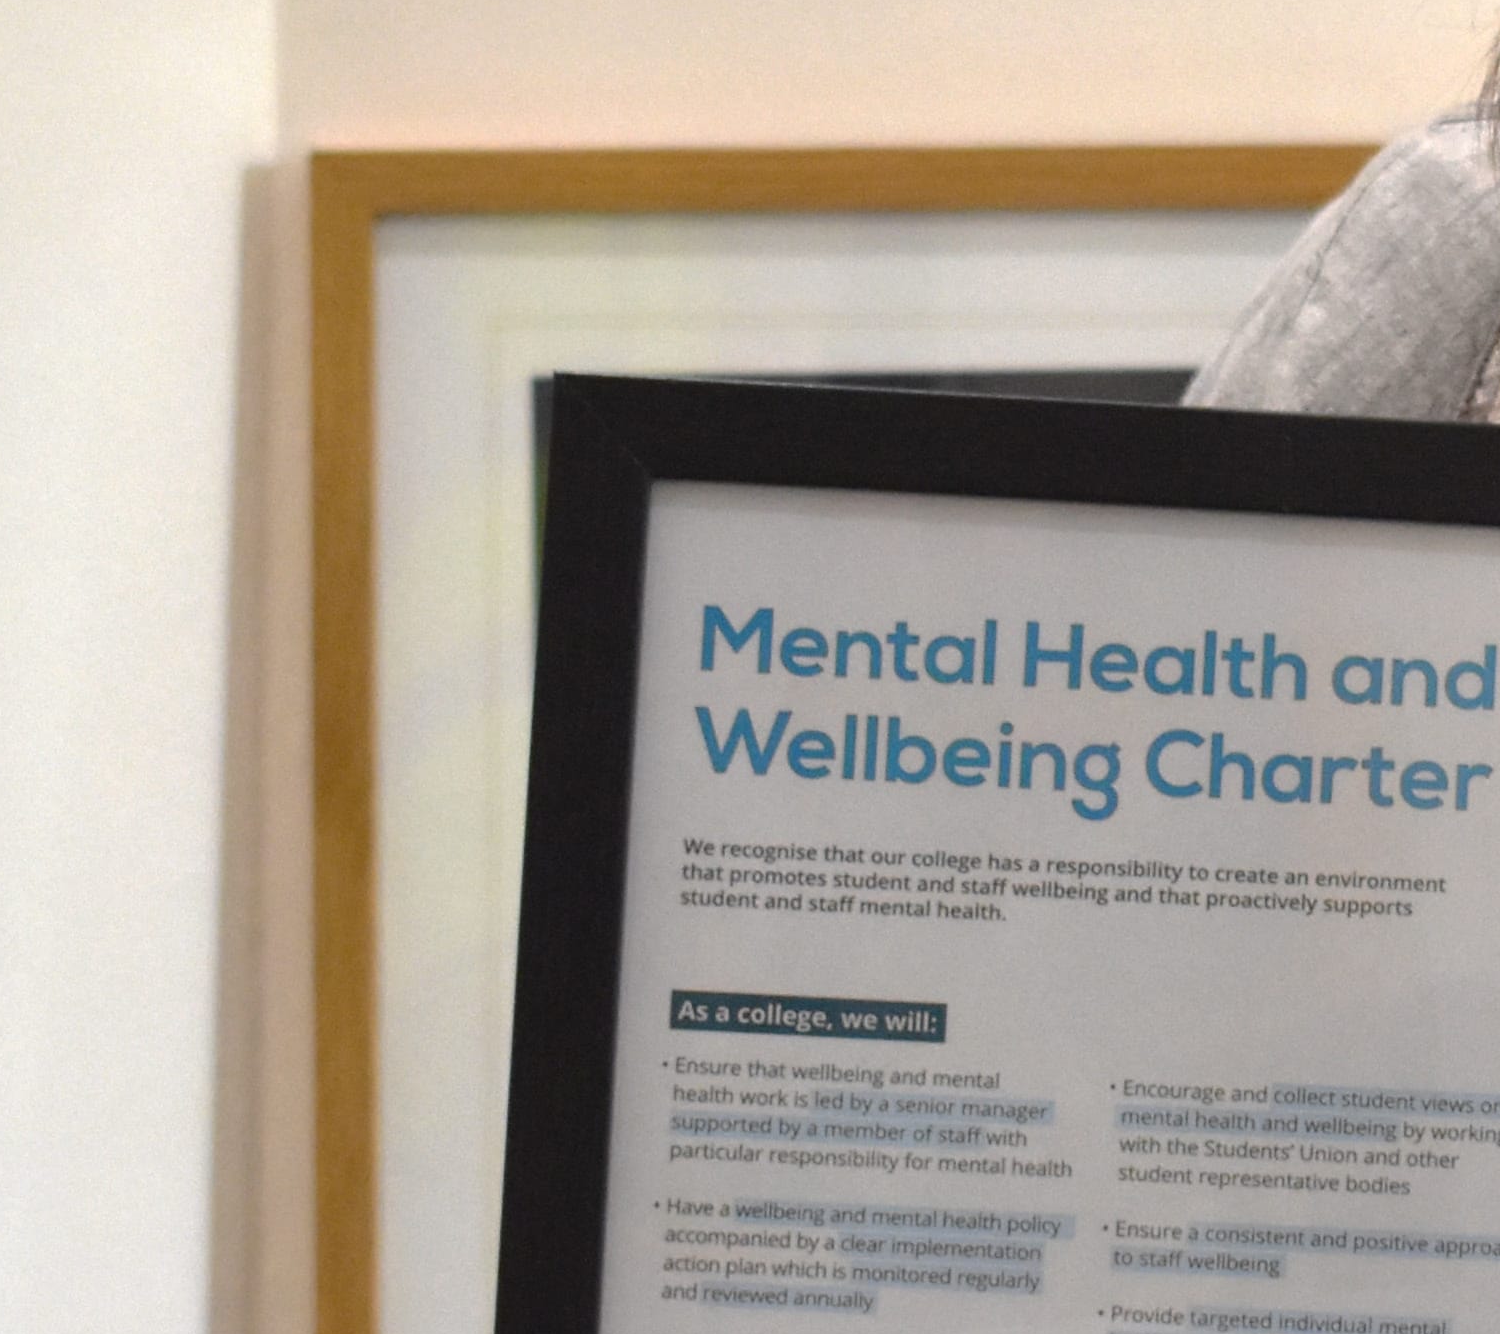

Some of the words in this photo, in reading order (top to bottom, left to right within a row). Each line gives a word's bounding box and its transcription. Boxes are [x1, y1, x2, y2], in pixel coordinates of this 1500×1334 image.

[700, 604, 998, 686] Mental
[1022, 620, 1308, 701] Health
[1331, 644, 1498, 711] and
[694, 705, 1121, 822] Wellbeing
[1145, 728, 1494, 811] Charter
[683, 838, 715, 856] We
[720, 843, 817, 864] recognise
[823, 845, 865, 864] that
[870, 851, 906, 866] our
[911, 851, 982, 874] college
[987, 852, 1023, 872] has
[1028, 859, 1040, 873] a
[1046, 860, 1184, 884] responsibility
[1188, 865, 1209, 881] to
[1214, 868, 1279, 885] create
[1284, 872, 1309, 886] an
[1315, 871, 1446, 893] environment
[680, 889, 759, 909] student
[764, 893, 803, 911] and
[808, 895, 855, 913] staff
[859, 899, 931, 917] mental
[936, 900, 1007, 921] health.
[682, 863, 724, 882] that
[729, 869, 827, 887] promotes
[833, 872, 911, 891] student
[917, 876, 955, 893] and
[961, 878, 1008, 896] staff
[1012, 881, 1109, 906] wellbeing
[1114, 886, 1152, 904] and
[1159, 886, 1200, 906] that
[1206, 893, 1318, 916] proactively
[1323, 899, 1413, 919] supports
[678, 1000, 708, 1021] As
[715, 1006, 730, 1022] a
[738, 1004, 832, 1030] college,
[841, 1013, 877, 1030] we
[885, 1011, 936, 1033] will:
[675, 1056, 742, 1077] Ensure
[747, 1060, 786, 1079] that
[791, 1064, 884, 1089] wellbeing
[889, 1069, 927, 1087] and
[932, 1072, 1000, 1089] mental
[672, 1084, 734, 1104] health
[739, 1089, 788, 1107] work
[793, 1091, 809, 1109] is
[815, 1090, 844, 1110] led
[849, 1092, 873, 1116] by
[878, 1099, 889, 1113] a
[895, 1099, 955, 1116] senior
[961, 1103, 1048, 1125] manager
[672, 1116, 773, 1135] supported
[778, 1117, 801, 1141] by
[806, 1123, 818, 1137] a
[824, 1123, 906, 1141] member
[913, 1124, 934, 1143] of
[938, 1126, 982, 1145] staff
[986, 1129, 1028, 1147] with
[669, 1144, 764, 1163] particular
[768, 1149, 899, 1174] responsibility
[904, 1151, 933, 1171] for
[937, 1157, 1006, 1175] mental
[1011, 1157, 1073, 1178] health
